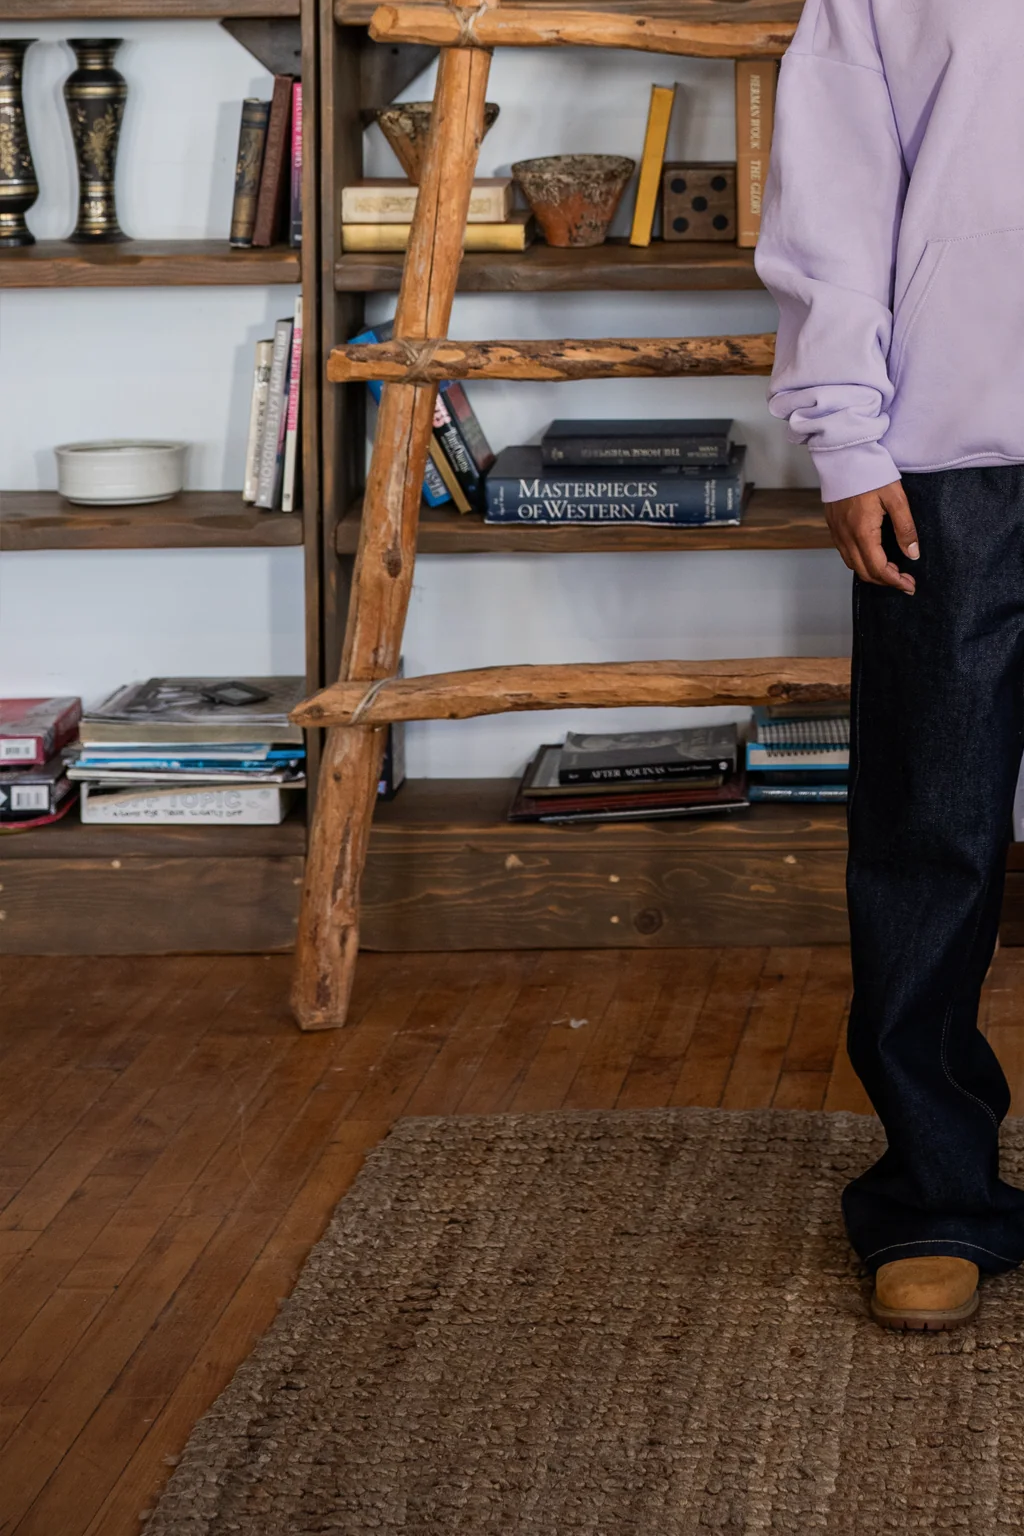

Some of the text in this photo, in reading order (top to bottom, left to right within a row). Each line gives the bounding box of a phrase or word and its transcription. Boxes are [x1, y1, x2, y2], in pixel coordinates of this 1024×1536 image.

[750, 74, 760, 117] HERMAN
[750, 118, 760, 150] WOUK
[750, 159, 761, 180] THE
[268, 394, 282, 431] KATE
[260, 433, 278, 490] HUDSON
[518, 479, 658, 499] MASTERPIECES
[518, 500, 678, 518] OF WESTERN ART
[591, 767, 621, 780] AFTER
[624, 765, 665, 779] AQUINAS
